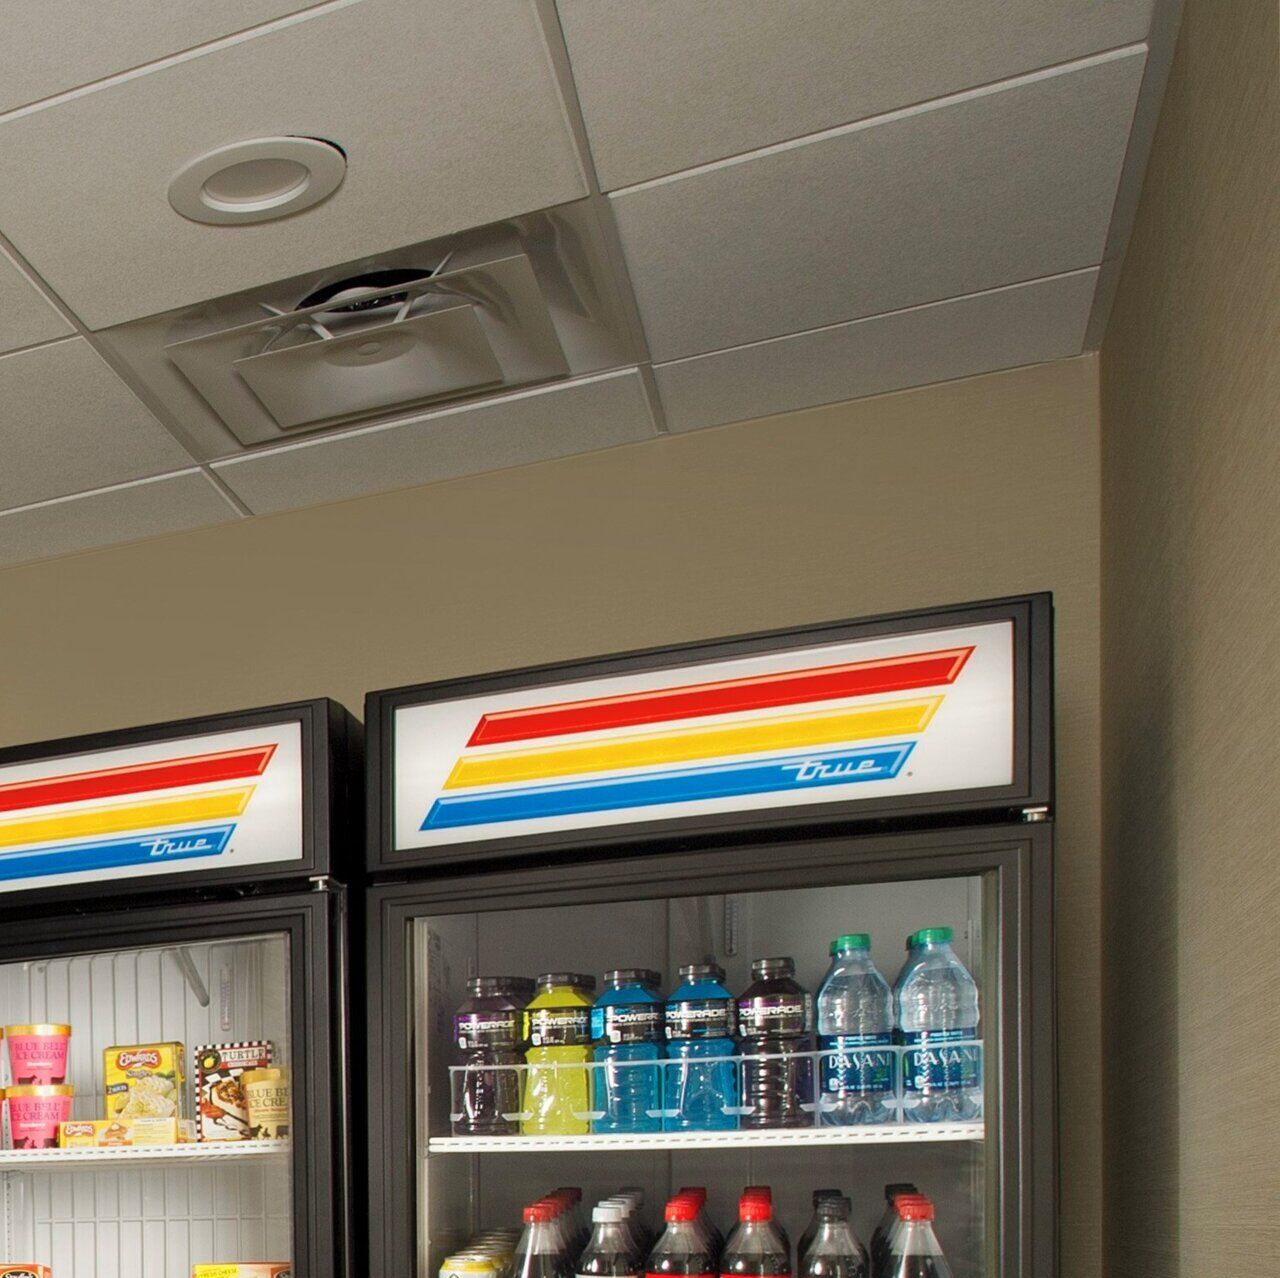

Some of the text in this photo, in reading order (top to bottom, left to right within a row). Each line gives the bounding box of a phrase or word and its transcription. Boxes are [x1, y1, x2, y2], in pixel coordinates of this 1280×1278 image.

[780, 758, 883, 781] true
[139, 836, 213, 857] true
[665, 1008, 727, 1020] POWERADE
[740, 1007, 802, 1020] POWERADE
[458, 1020, 515, 1031] POWERADE
[30, 1051, 65, 1060] CREAM
[222, 1048, 265, 1061] TURTLE
[828, 1051, 892, 1070] DASANI
[914, 1047, 978, 1067] DASANI
[23, 1112, 60, 1122] CREAM
